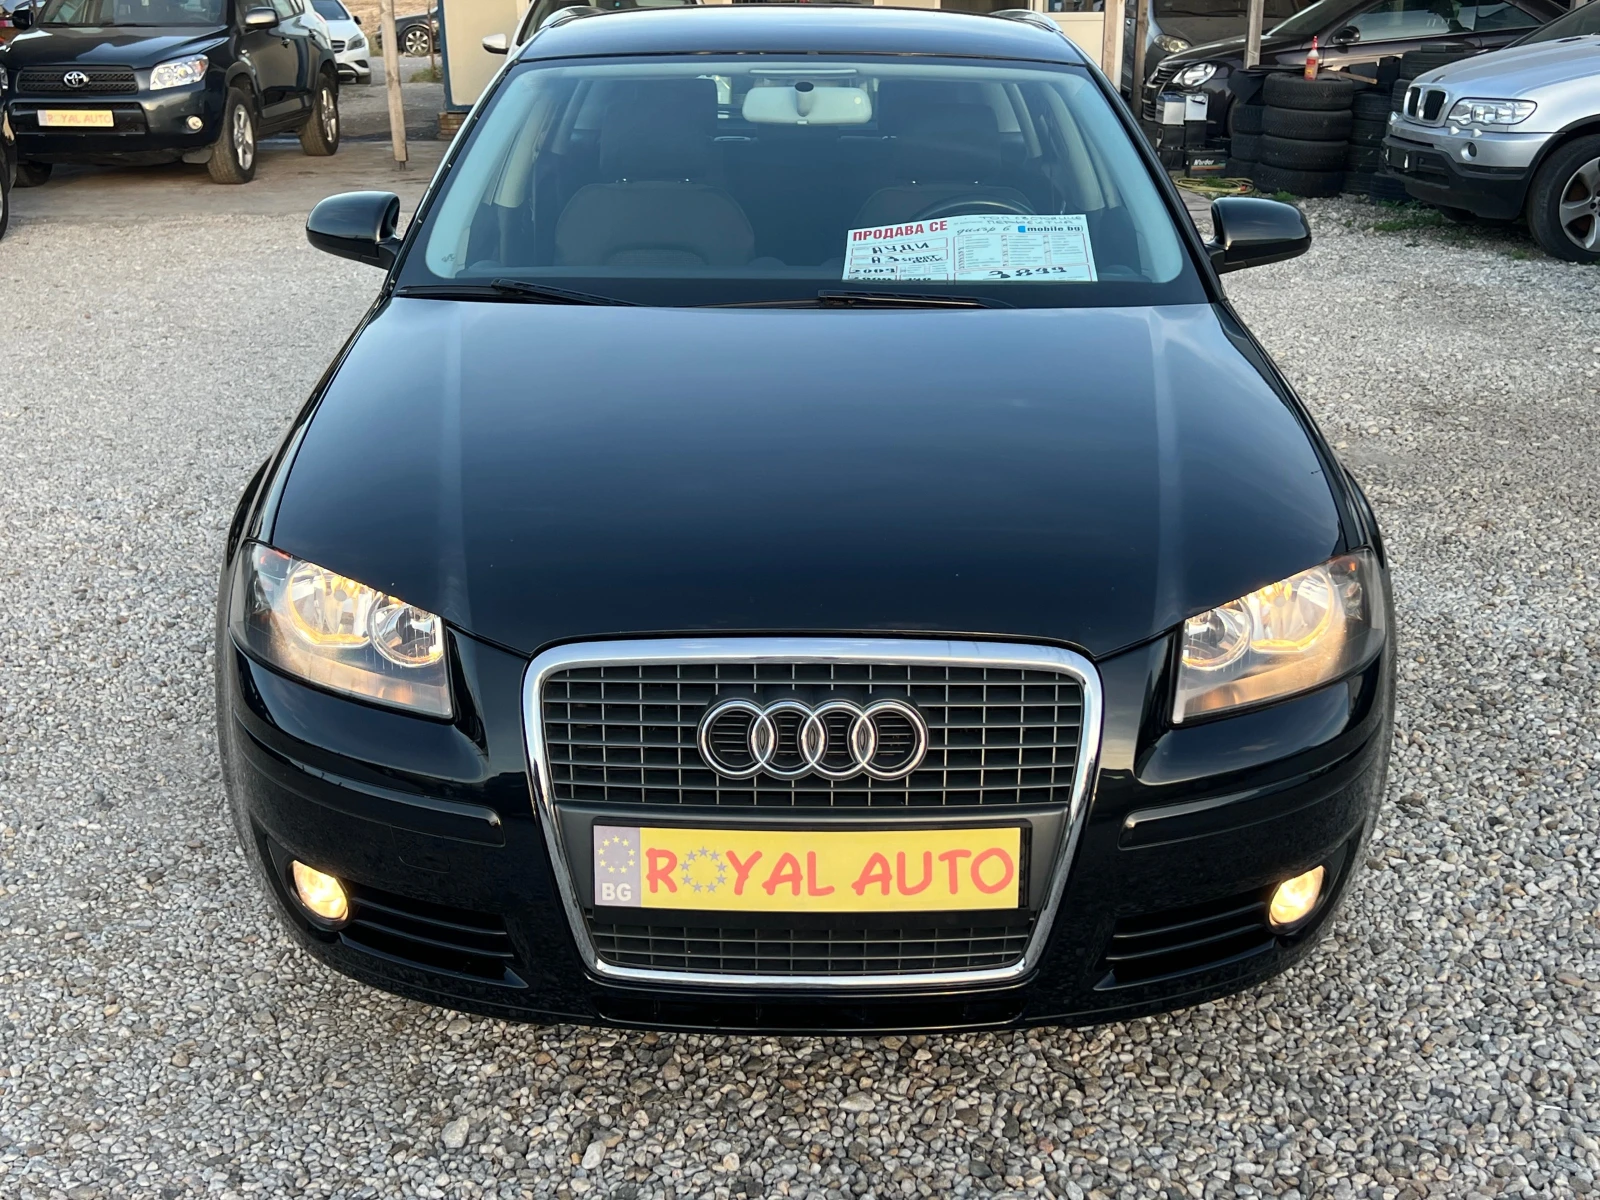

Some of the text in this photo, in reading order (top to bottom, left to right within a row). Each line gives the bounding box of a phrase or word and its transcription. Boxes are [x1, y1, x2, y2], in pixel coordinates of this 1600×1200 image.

[84, 114, 112, 124] AUTO
[852, 220, 948, 242] ПРОДАВА СЕ
[872, 242, 930, 254] АУДИ
[851, 847, 1015, 897] AUTO
[601, 882, 632, 901] BG
